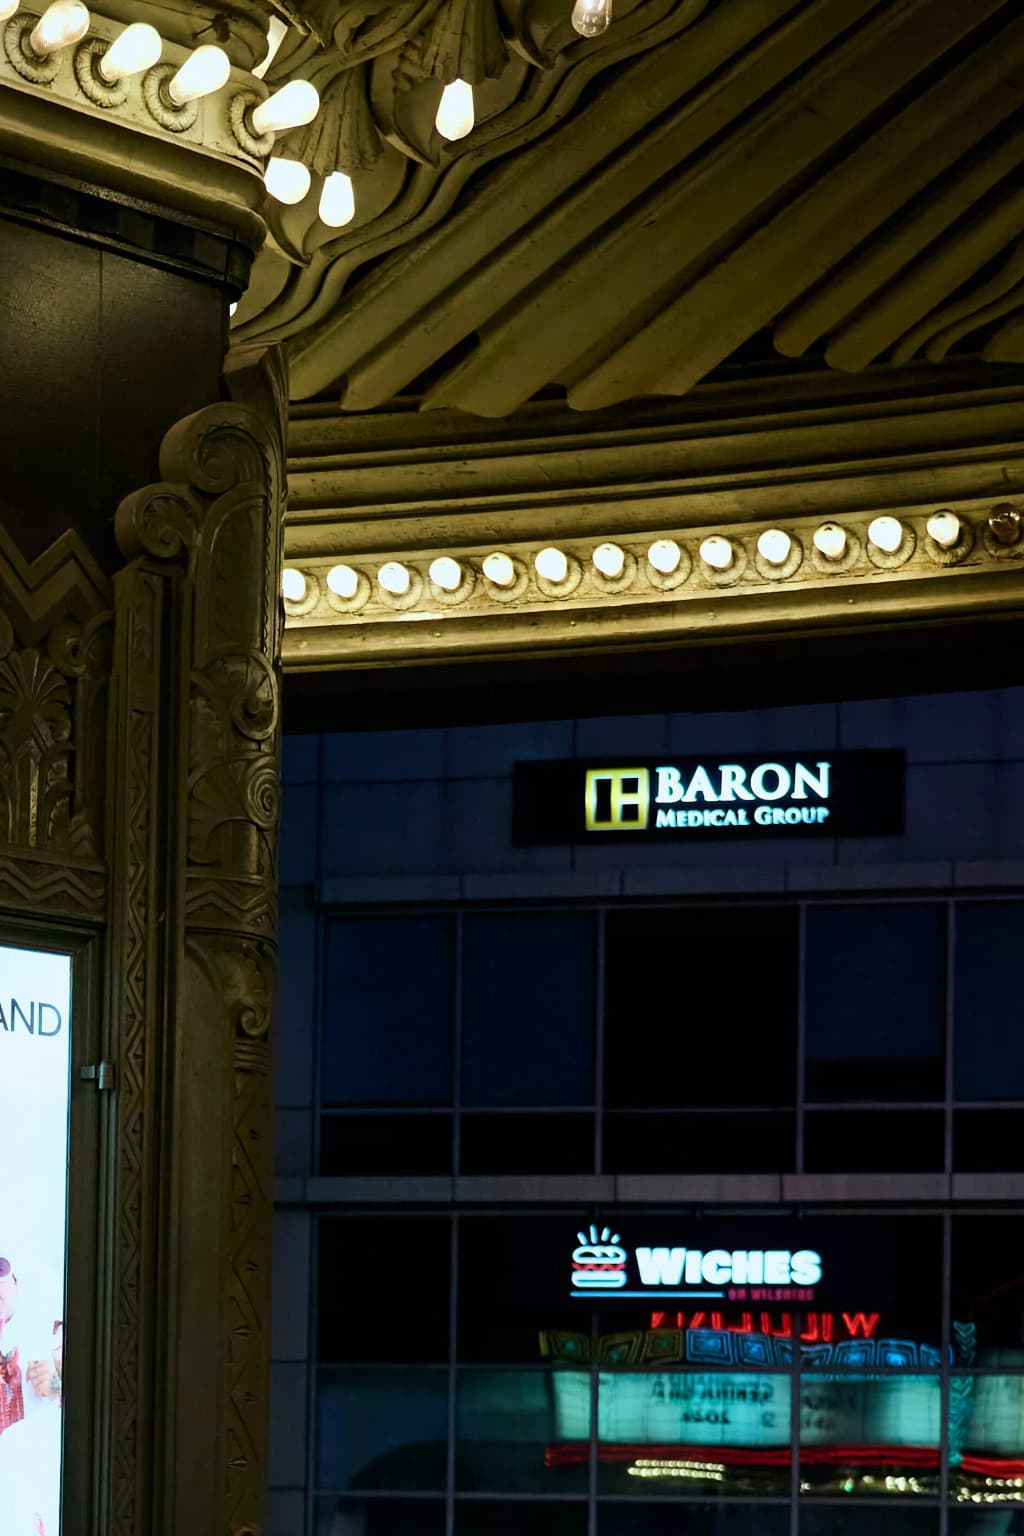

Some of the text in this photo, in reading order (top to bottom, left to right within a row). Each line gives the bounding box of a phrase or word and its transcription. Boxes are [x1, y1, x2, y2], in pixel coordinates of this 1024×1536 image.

[654, 761, 832, 804] BARON
[655, 805, 831, 829] MEDICAL GROUP
[635, 1246, 824, 1287] WICHES
